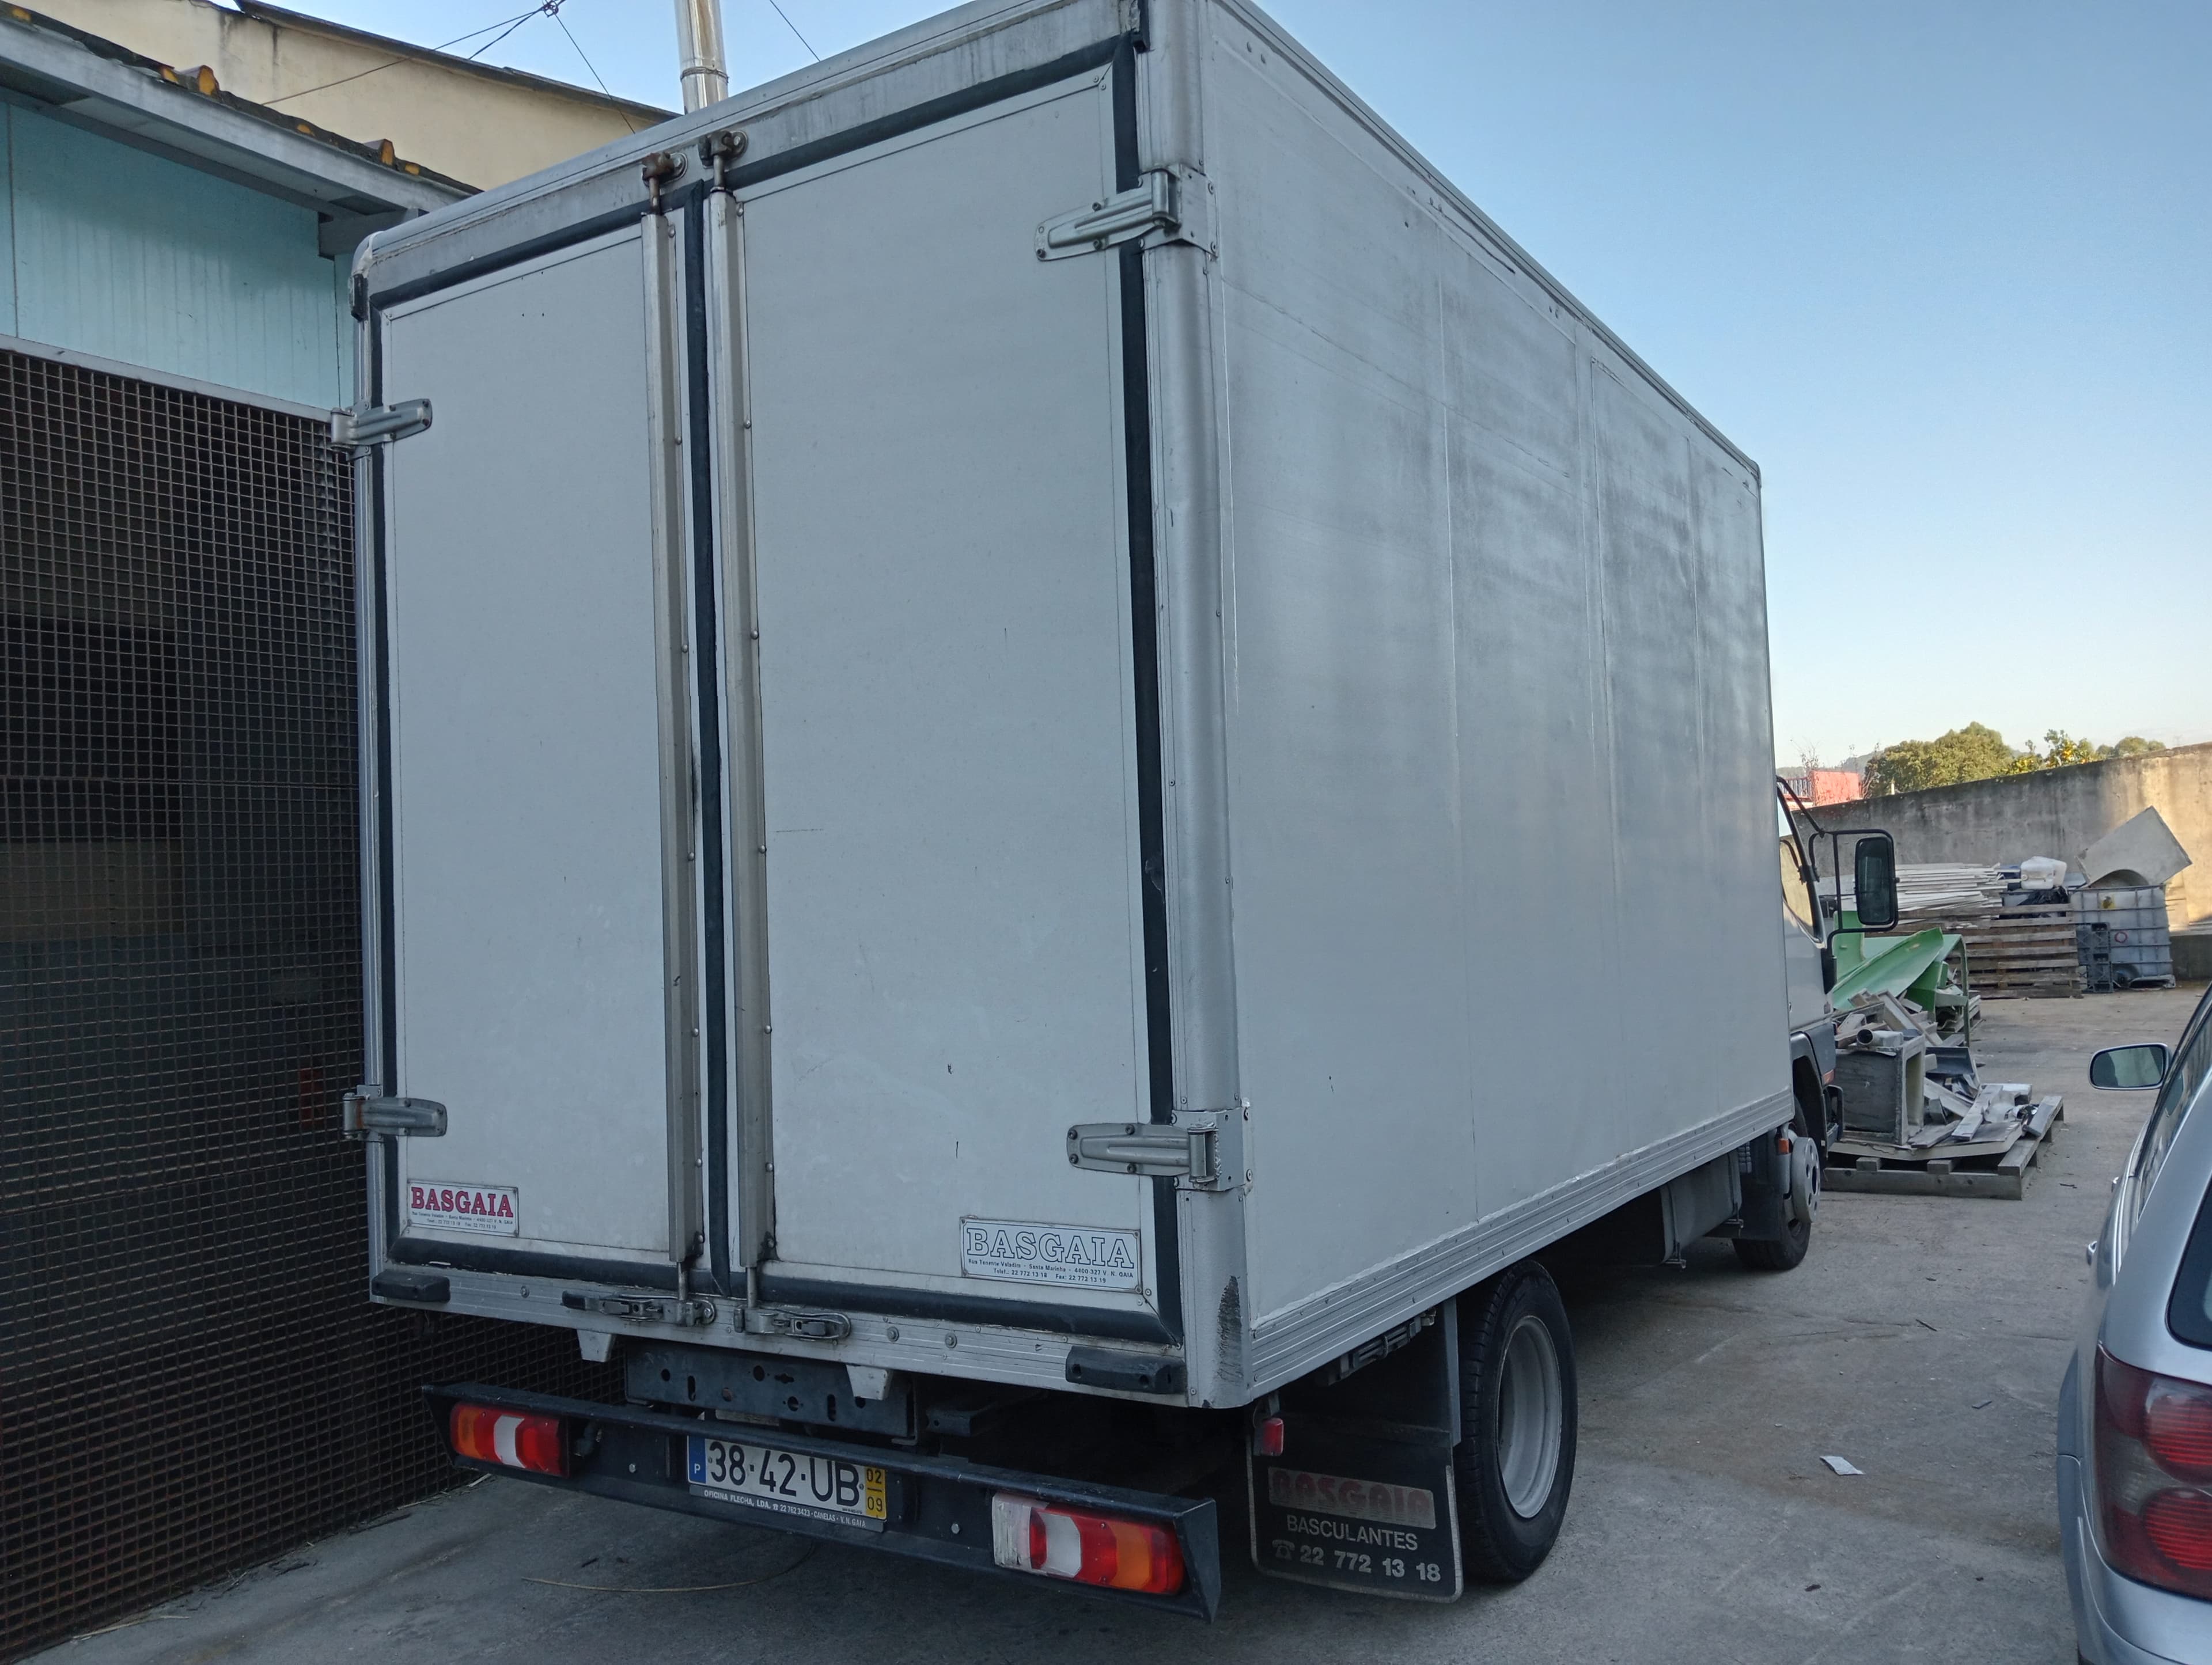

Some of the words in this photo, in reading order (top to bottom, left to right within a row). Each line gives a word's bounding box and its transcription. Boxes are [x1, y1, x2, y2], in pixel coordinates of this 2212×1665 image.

[411, 1187, 513, 1218] BASGAIA
[967, 1227, 1134, 1269] BASGAIA
[694, 1463, 700, 1474] P
[866, 1467, 883, 1484] 02
[704, 1489, 728, 1501] OFICINA
[757, 1499, 771, 1509] LDA.
[813, 1511, 835, 1522] CANELAS
[867, 1497, 883, 1512] 09
[1287, 1515, 1418, 1550] BASCULANTES
[1300, 1545, 1324, 1565] 22
[1334, 1550, 1372, 1573] 772
[1382, 1558, 1405, 1577] 13
[1416, 1562, 1441, 1582] 18
